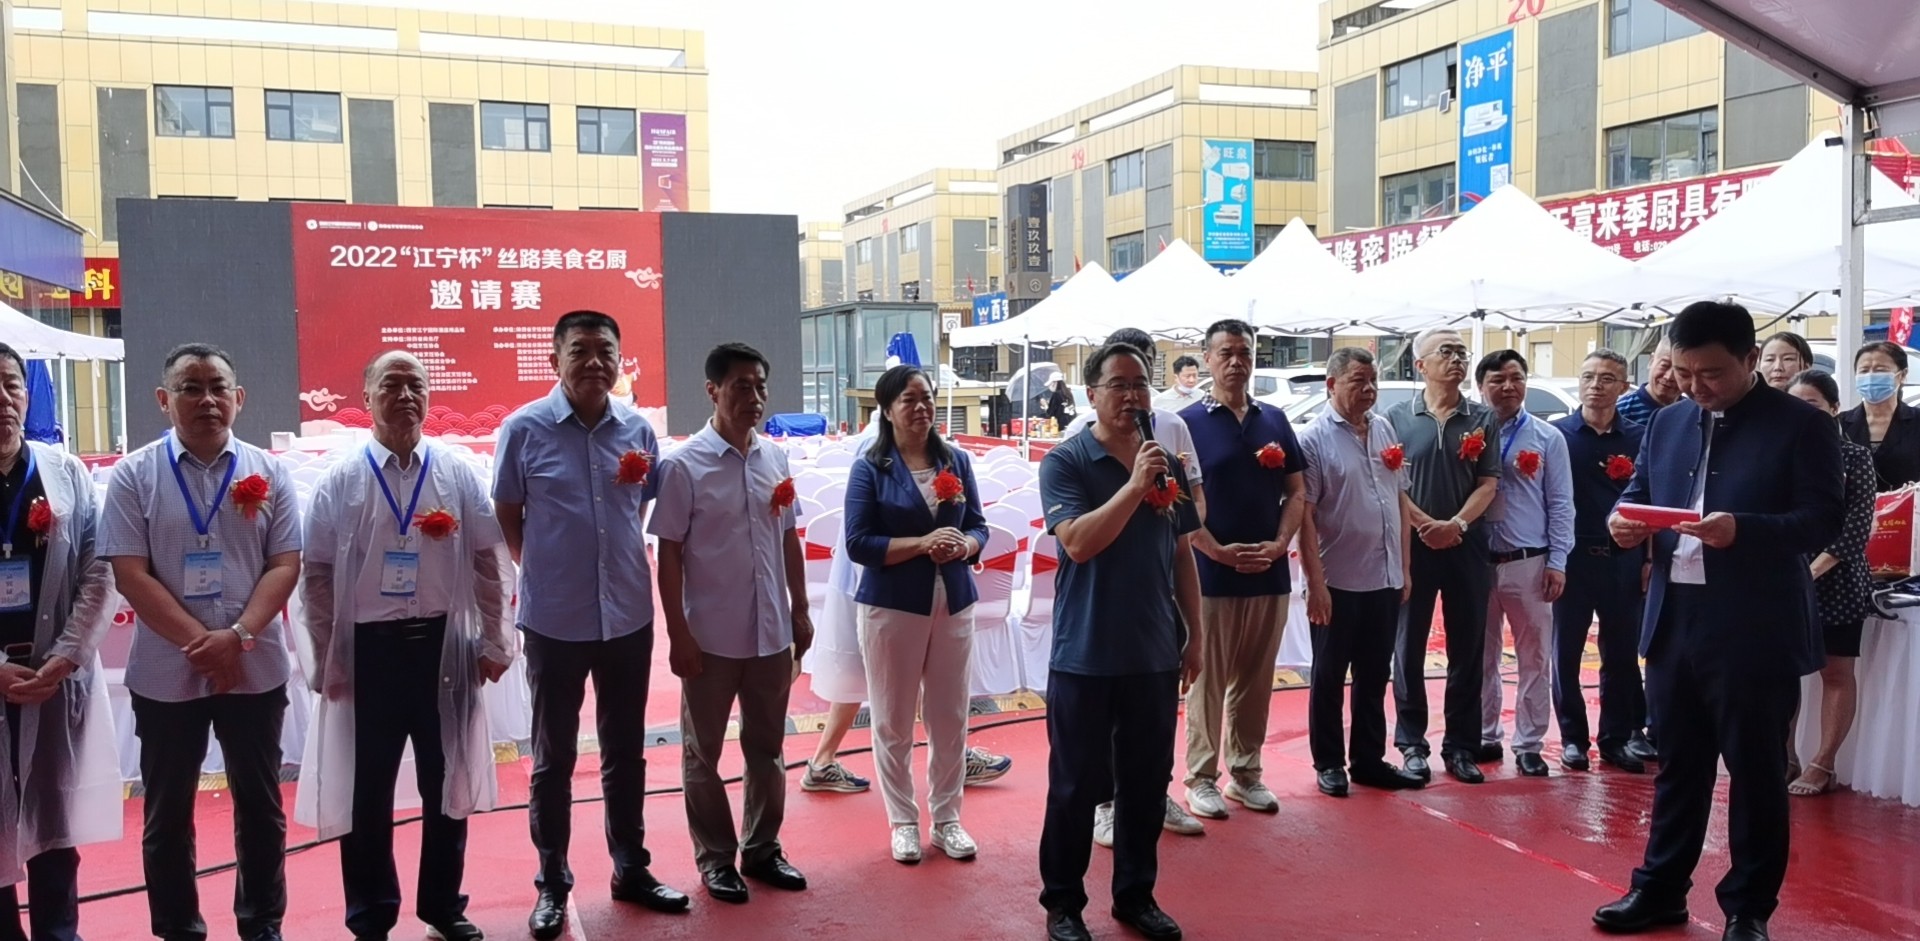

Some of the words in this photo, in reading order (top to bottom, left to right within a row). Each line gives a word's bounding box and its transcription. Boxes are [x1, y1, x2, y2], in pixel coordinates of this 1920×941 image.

[1465, 47, 1508, 89] 净平
[1027, 216, 1041, 267] 壹玖玖壹
[430, 279, 542, 310] 邀请赛
